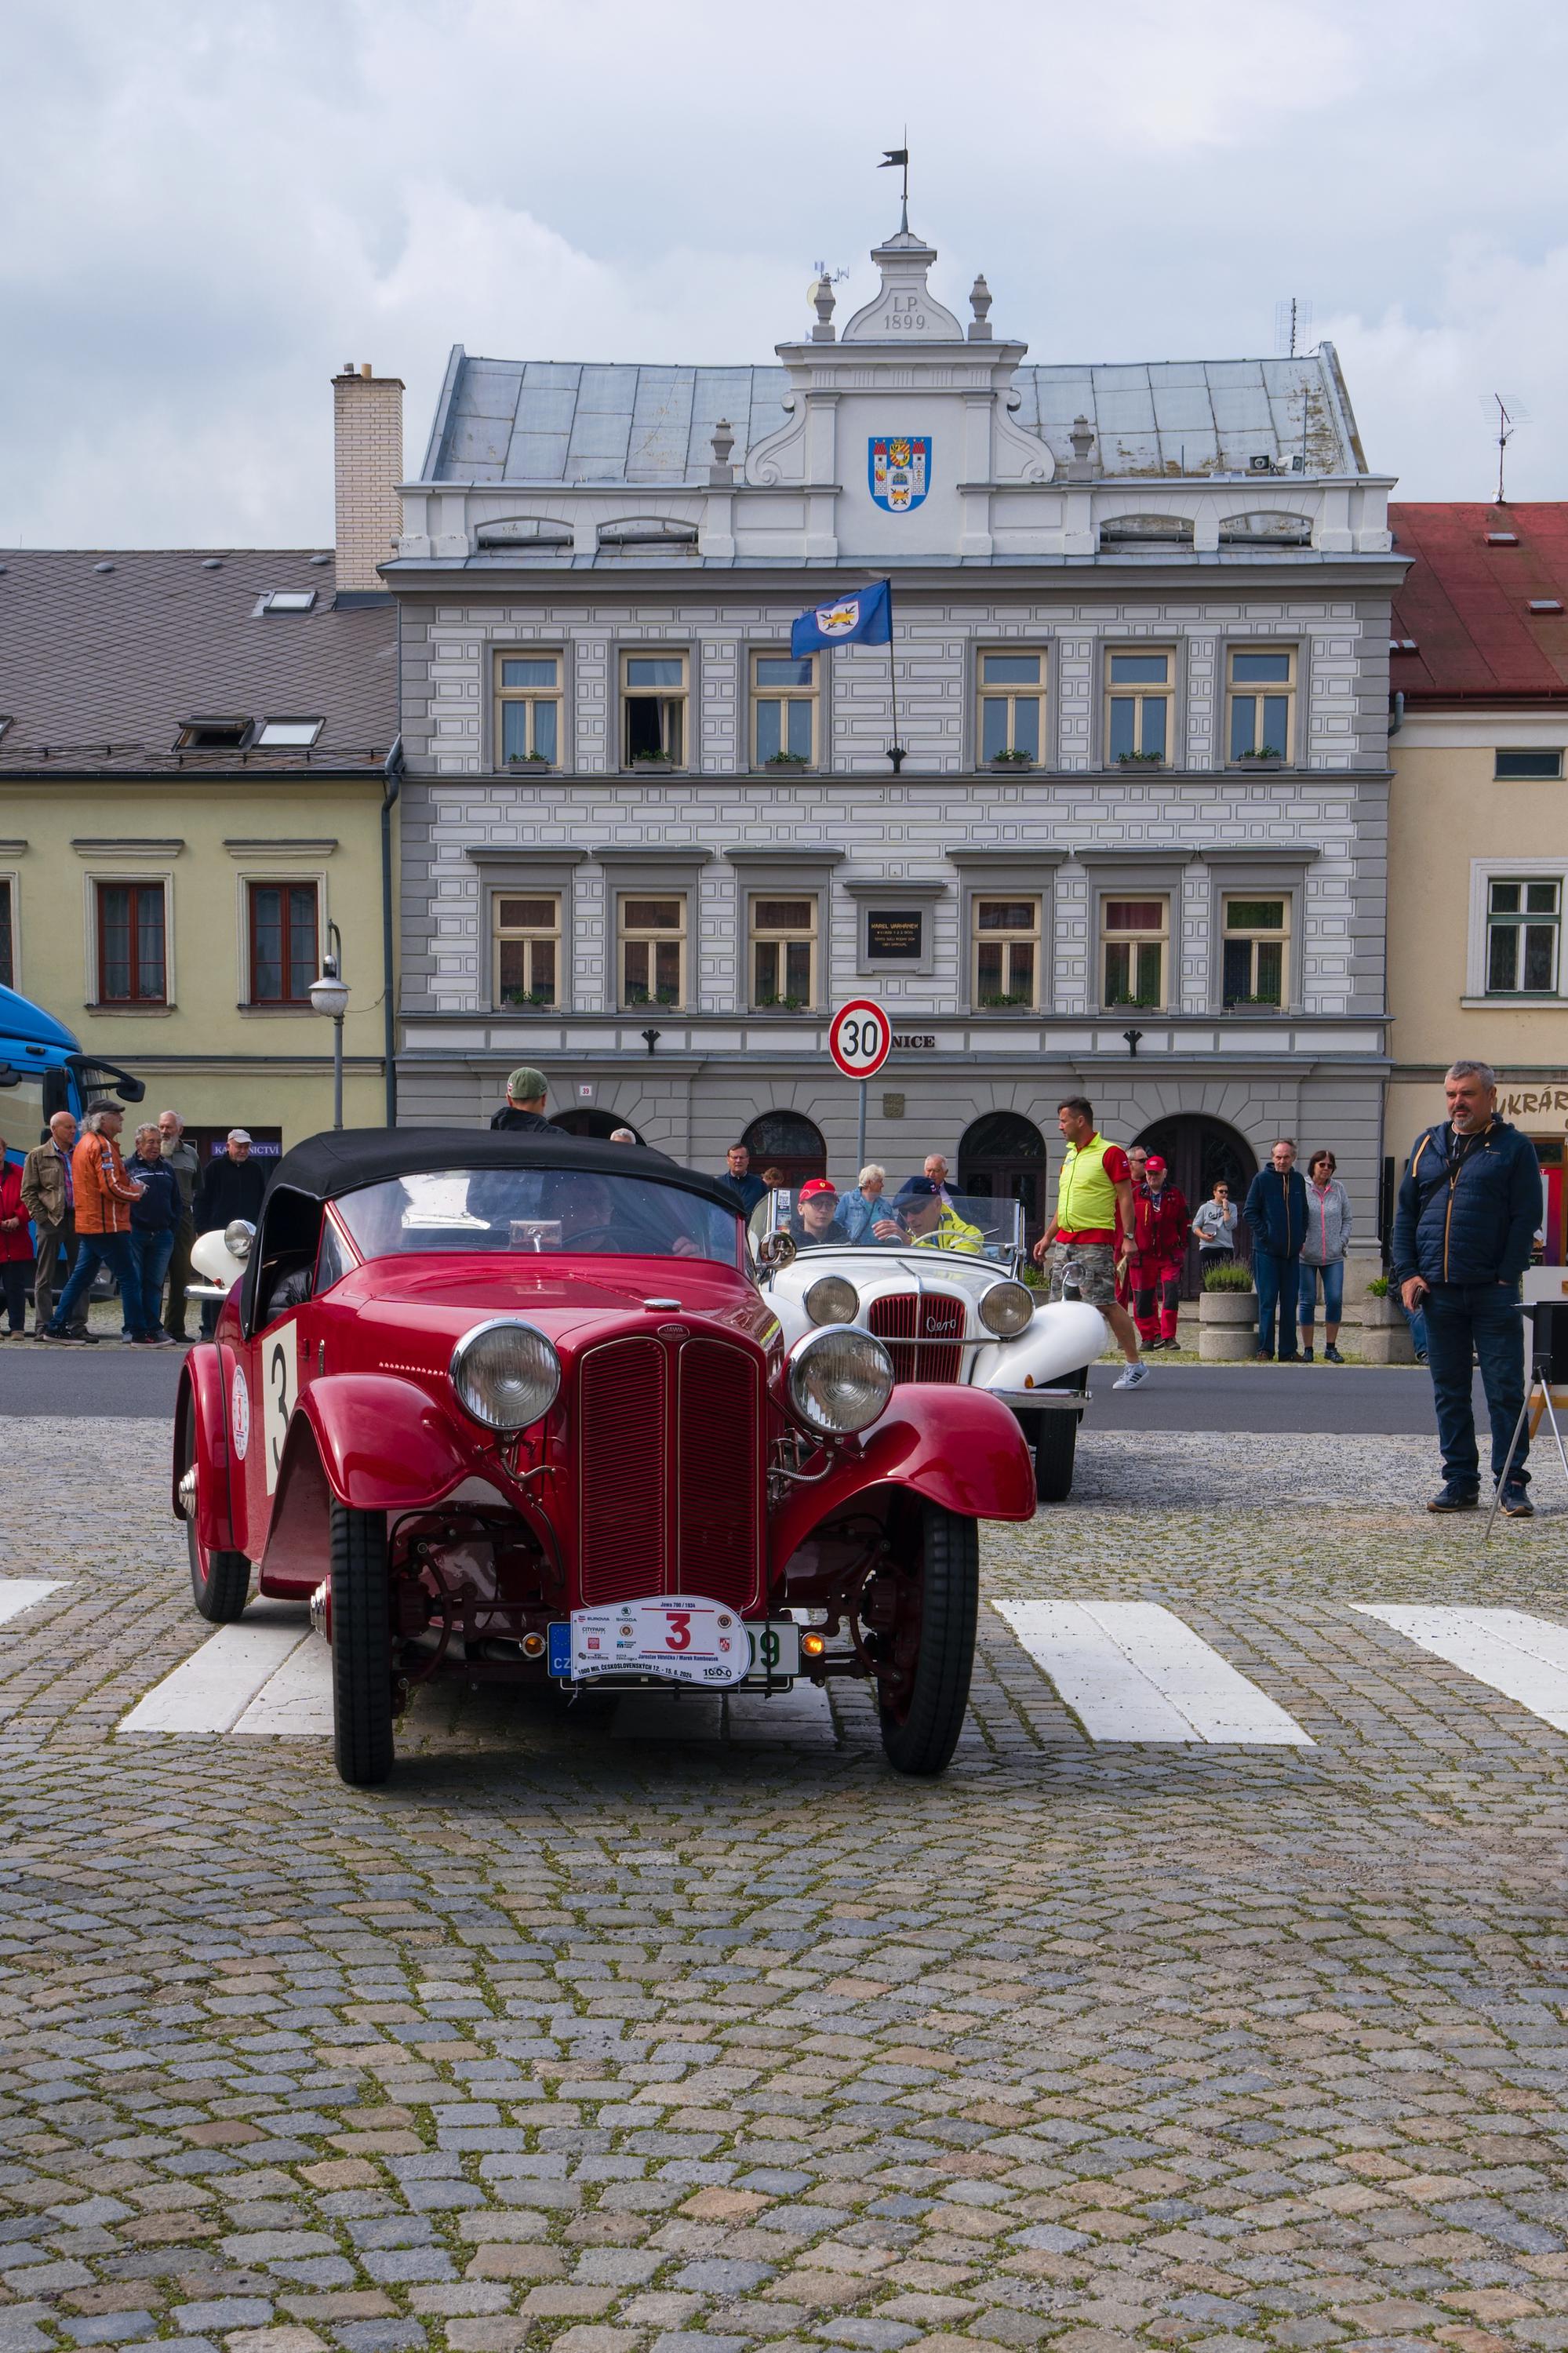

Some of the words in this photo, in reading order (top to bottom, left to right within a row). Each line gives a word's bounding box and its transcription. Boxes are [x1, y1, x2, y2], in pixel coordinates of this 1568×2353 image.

[842, 1020, 878, 1057] 30
[892, 1035, 935, 1048] NICE
[1493, 1086, 1568, 1117] UKRÁR
[215, 1144, 279, 1155] KANICTVÍ
[271, 1343, 289, 1473] 3
[665, 1613, 691, 1650] 3
[554, 1658, 571, 1669] CZ
